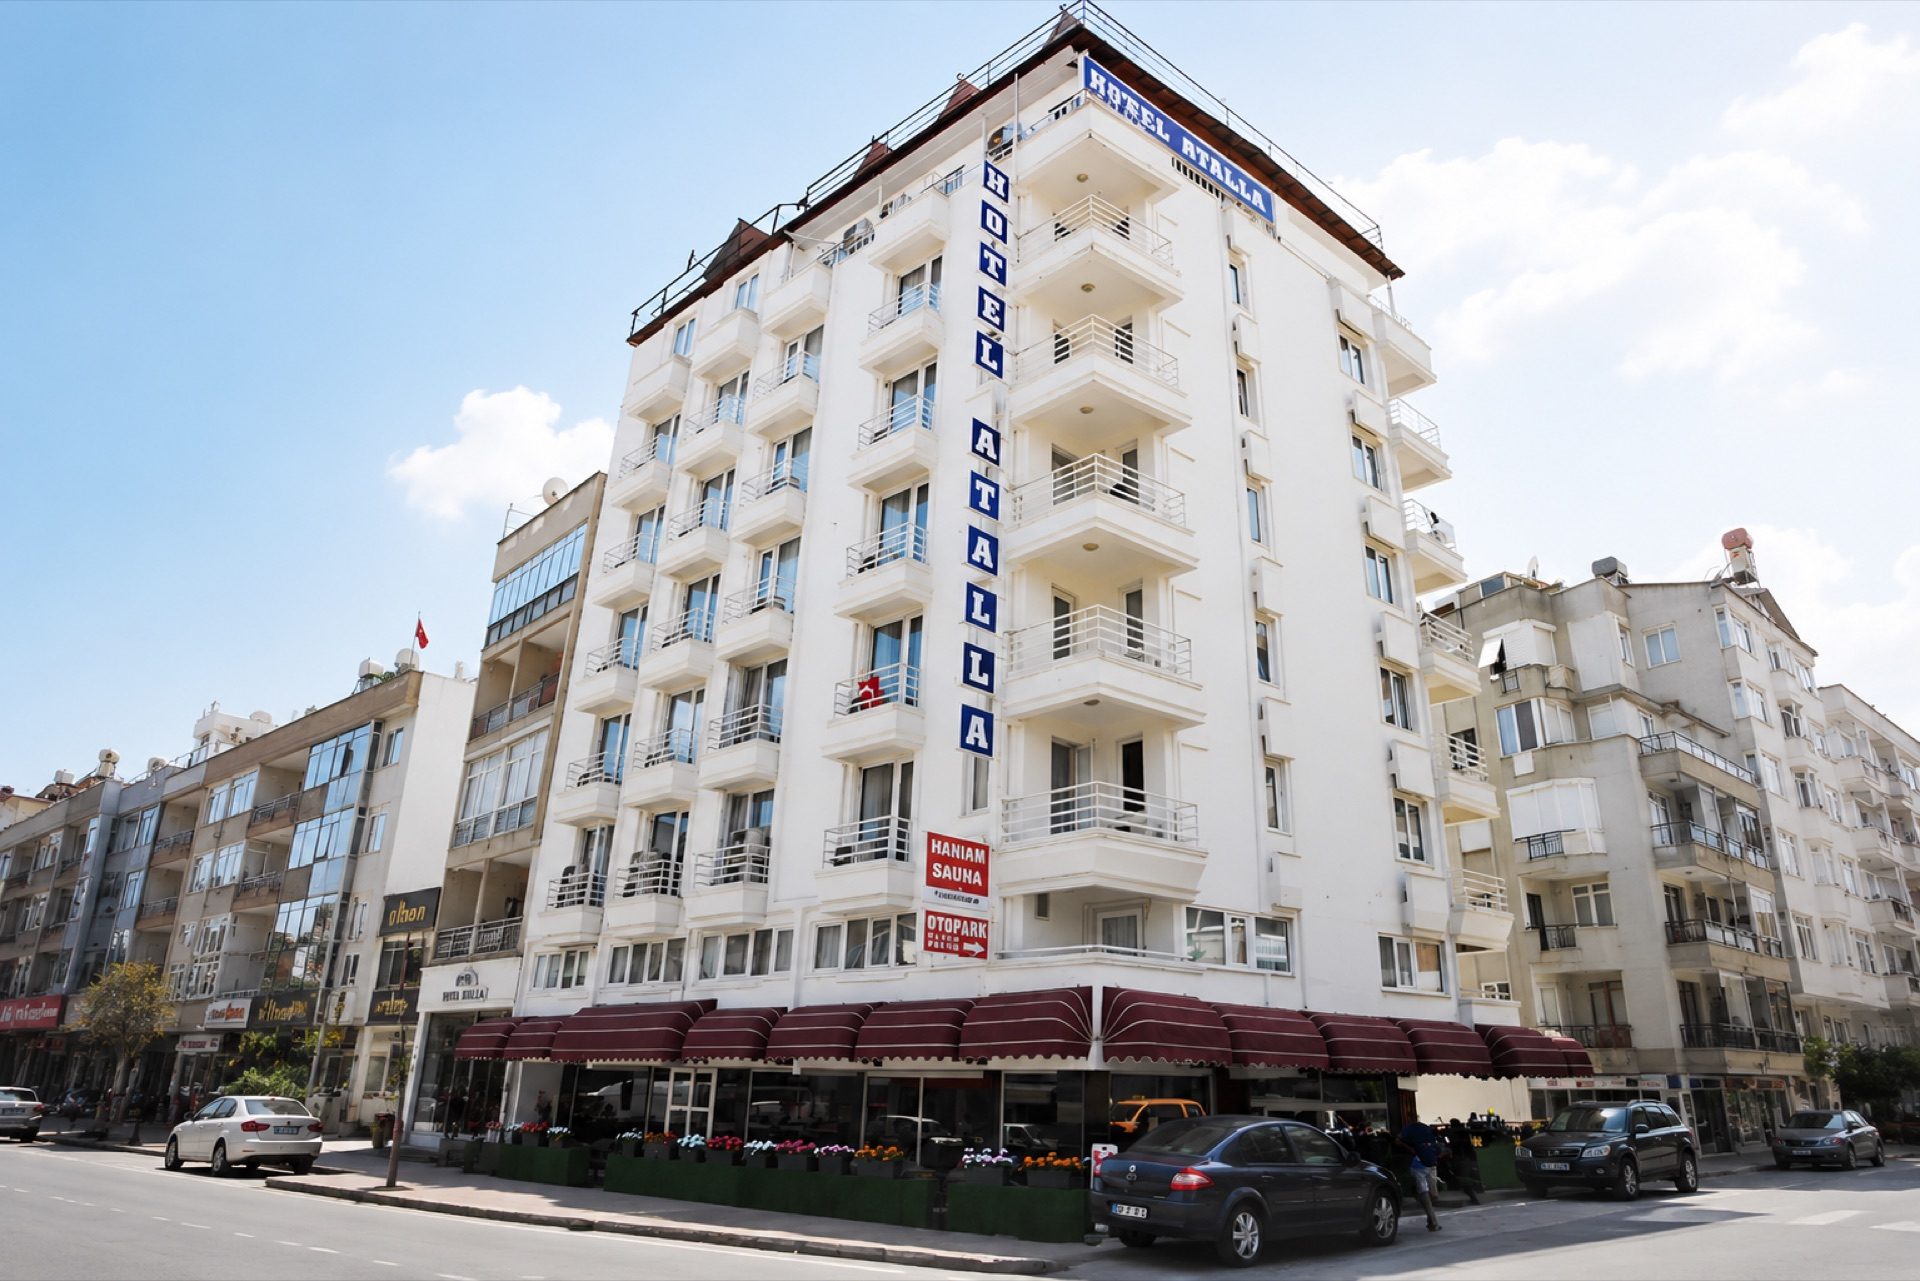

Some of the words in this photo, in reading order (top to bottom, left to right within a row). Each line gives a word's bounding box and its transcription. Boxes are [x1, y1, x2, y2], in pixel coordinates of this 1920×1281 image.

[1089, 68, 1170, 143] HOTEL
[1181, 136, 1267, 213] ATALLA
[981, 167, 1006, 371] HOTEL
[966, 428, 997, 749] ATALLA
[927, 915, 987, 939] OTOPARK
[932, 862, 982, 887] SAUNA
